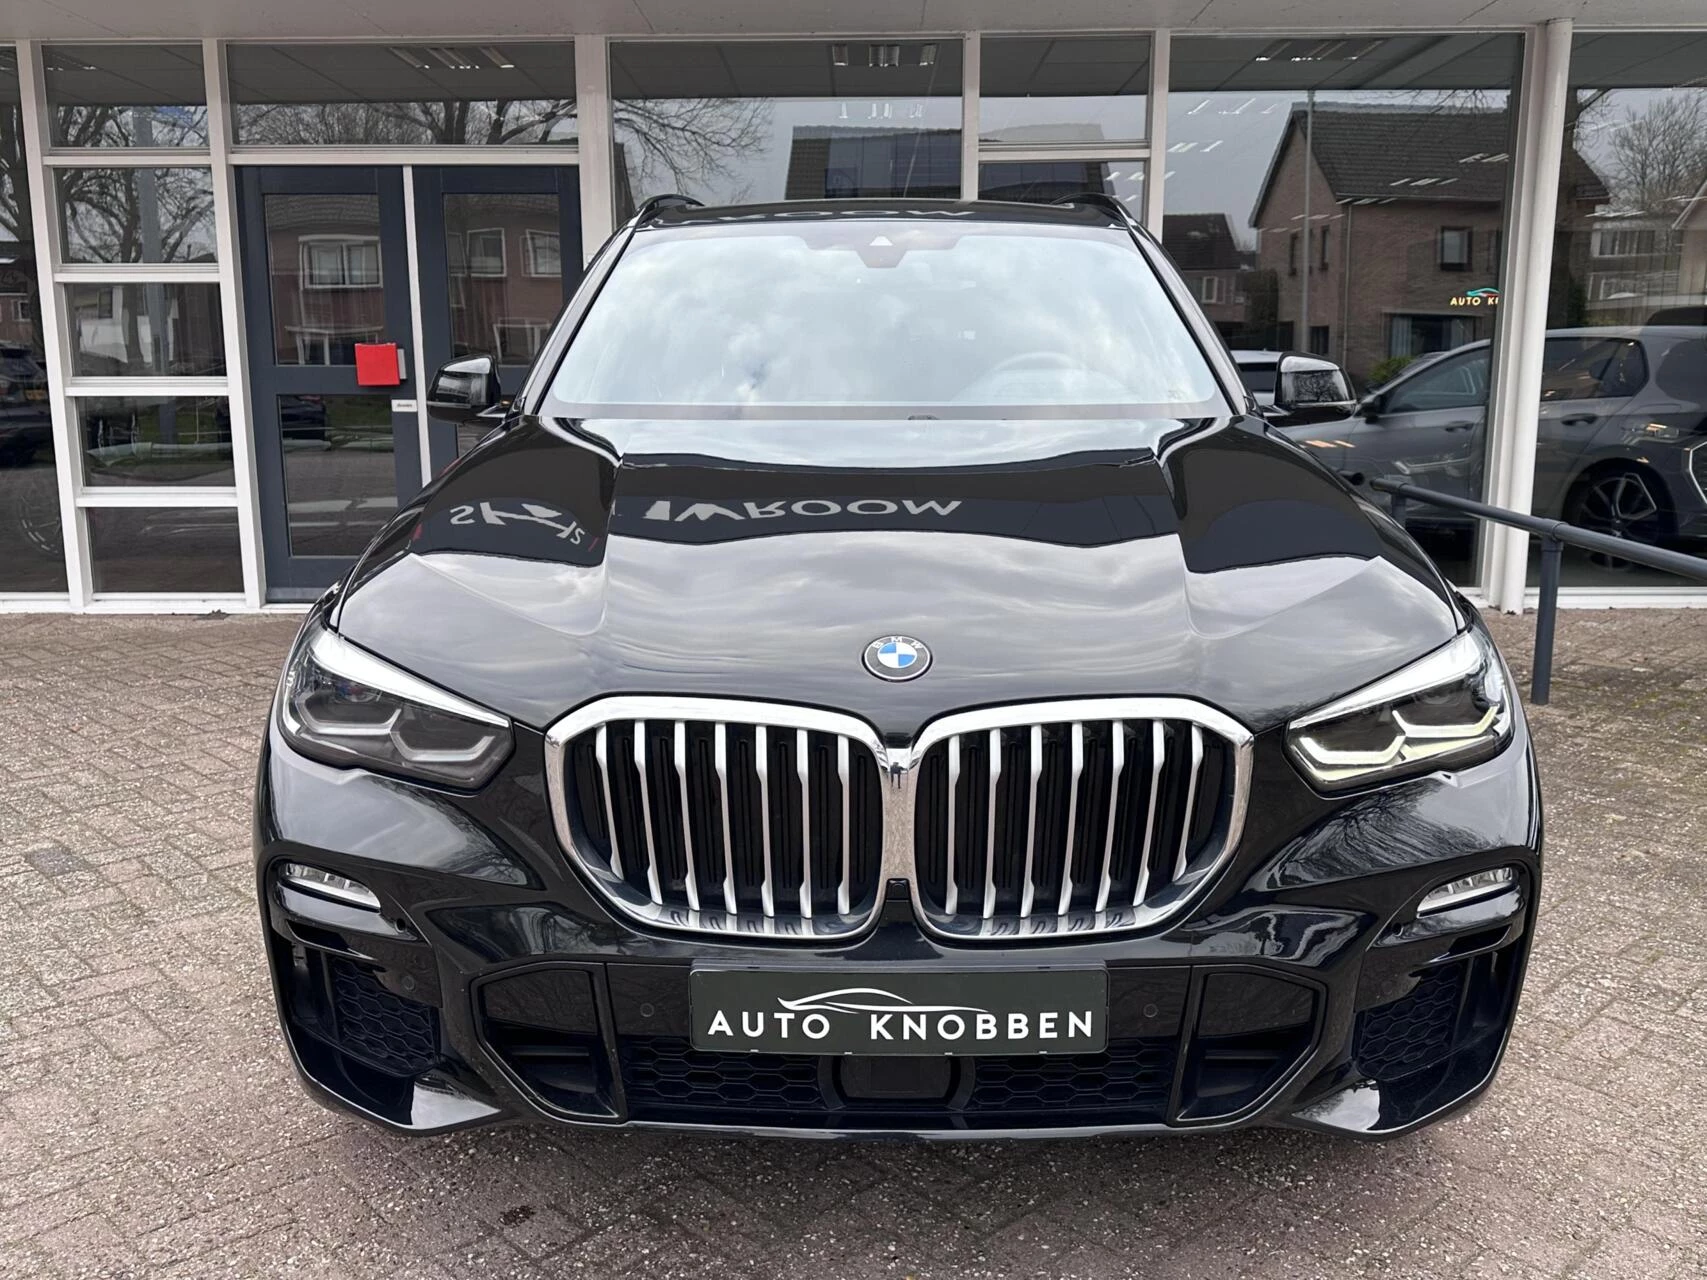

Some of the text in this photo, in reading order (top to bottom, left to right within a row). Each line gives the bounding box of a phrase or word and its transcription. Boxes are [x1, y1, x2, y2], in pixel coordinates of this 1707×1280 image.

[1450, 297, 1481, 306] AUTO
[707, 1010, 1093, 1040] AUTO KNOBBEN
